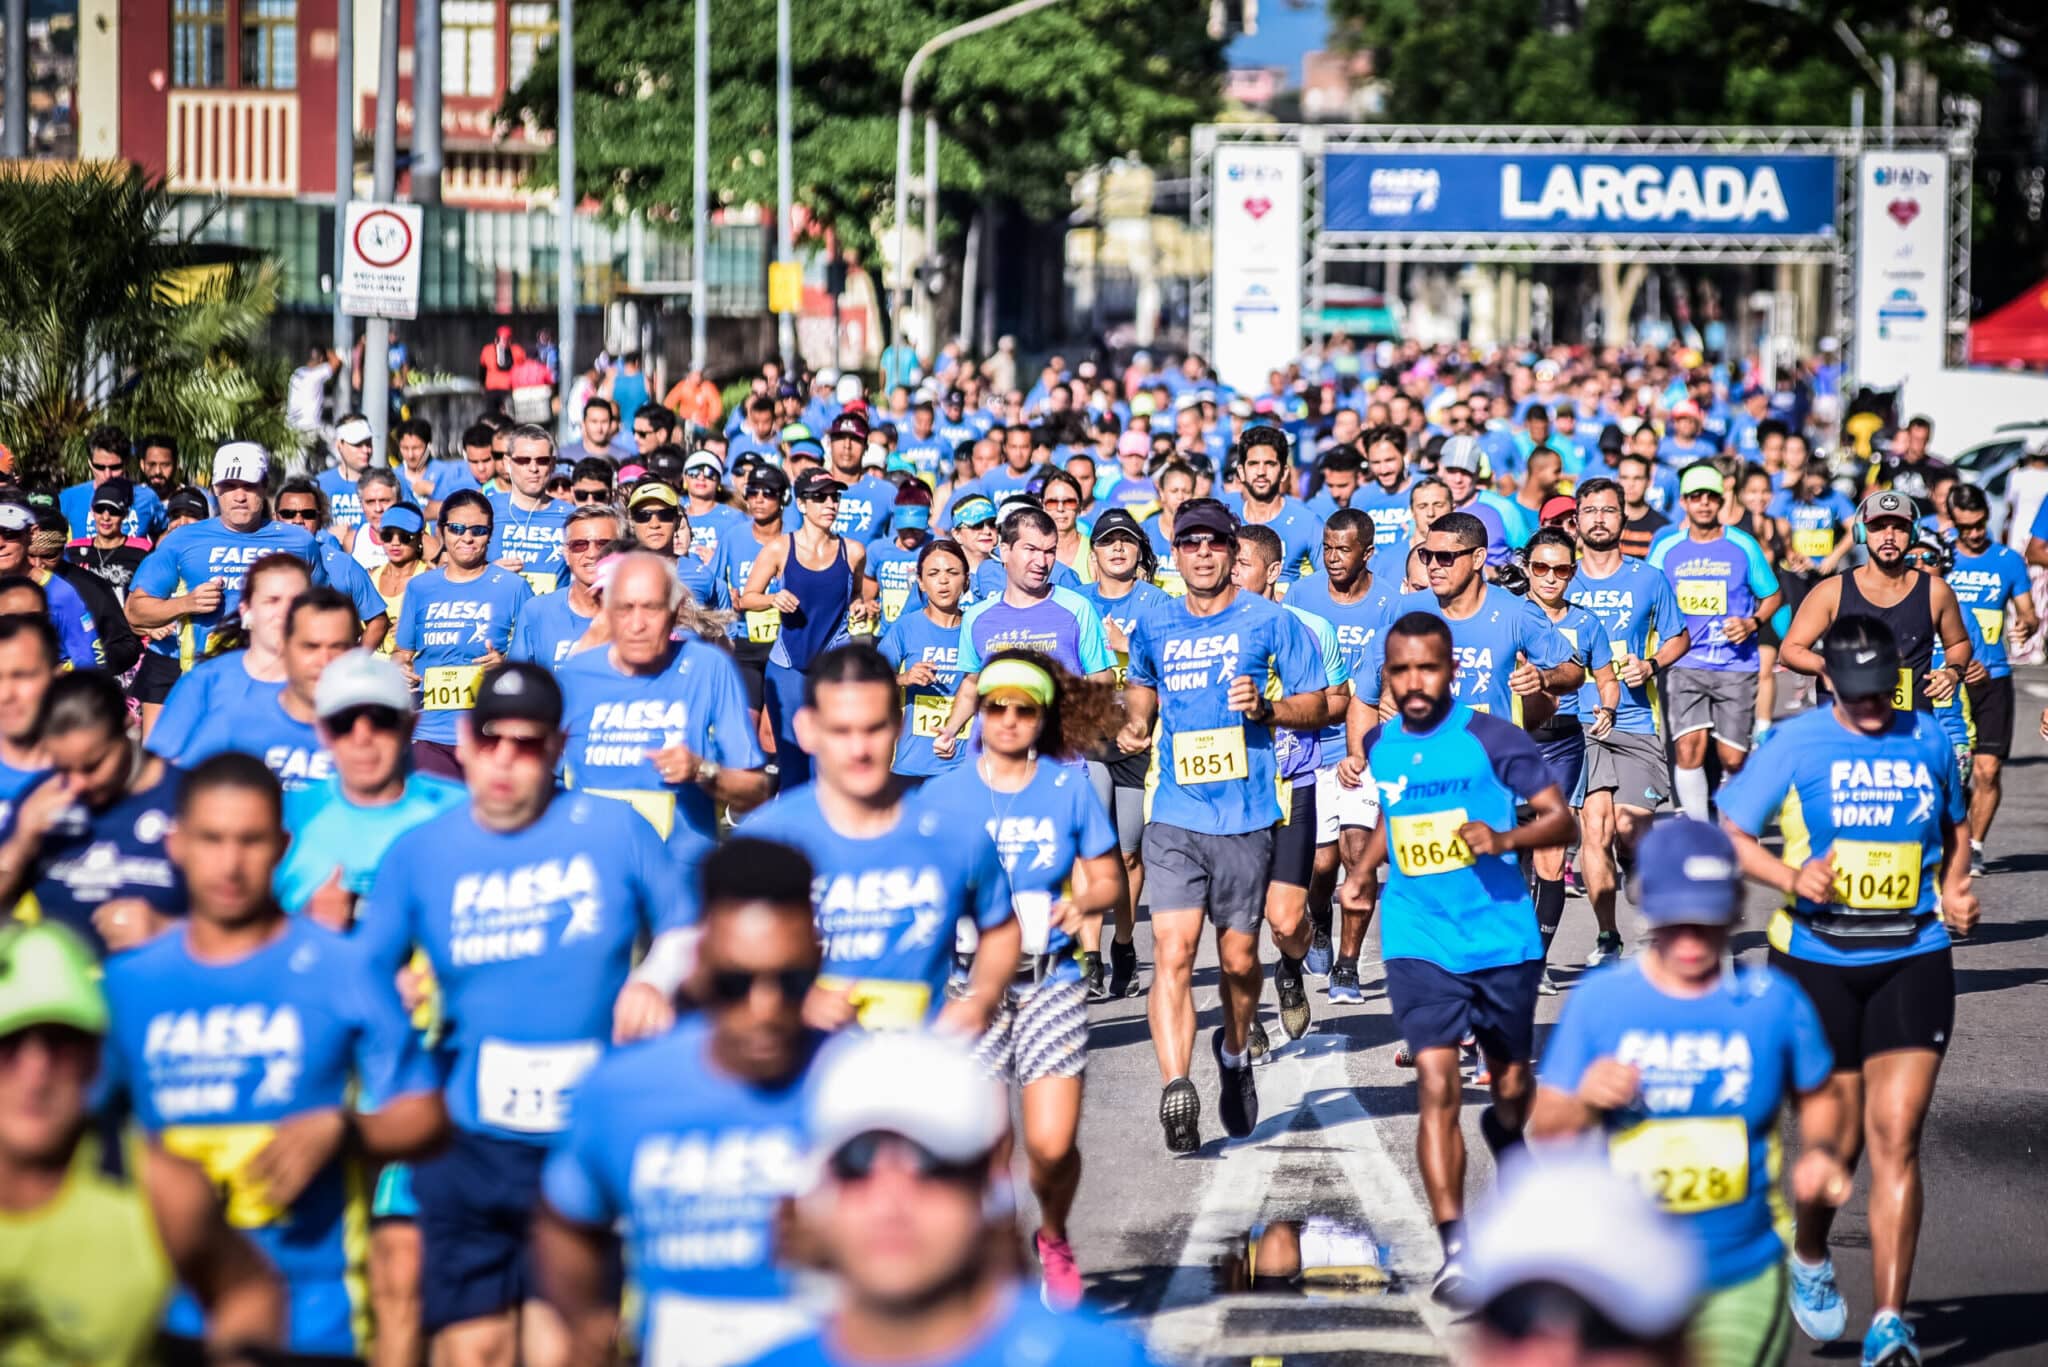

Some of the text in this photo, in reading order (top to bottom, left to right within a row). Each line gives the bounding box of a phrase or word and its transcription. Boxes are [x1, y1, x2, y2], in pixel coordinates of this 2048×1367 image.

[1501, 163, 1789, 222] LARGADA
[503, 524, 565, 542] FAESA
[425, 600, 492, 621] FAESA
[1681, 595, 1720, 611] 1842
[423, 631, 458, 646] 10KM
[1162, 633, 1239, 663] FAESA
[1163, 671, 1209, 692] 10KM
[426, 685, 475, 706] 1011
[589, 700, 687, 731] FAESA
[583, 744, 642, 767] 10KM
[1178, 752, 1234, 778] 1851
[1831, 759, 1935, 791] FAESA
[1853, 788, 1904, 803] CORRIDA
[1832, 804, 1895, 828] 10KM
[1399, 838, 1463, 868] 1864
[452, 854, 598, 915] FAESA
[1842, 873, 1912, 901] 1042
